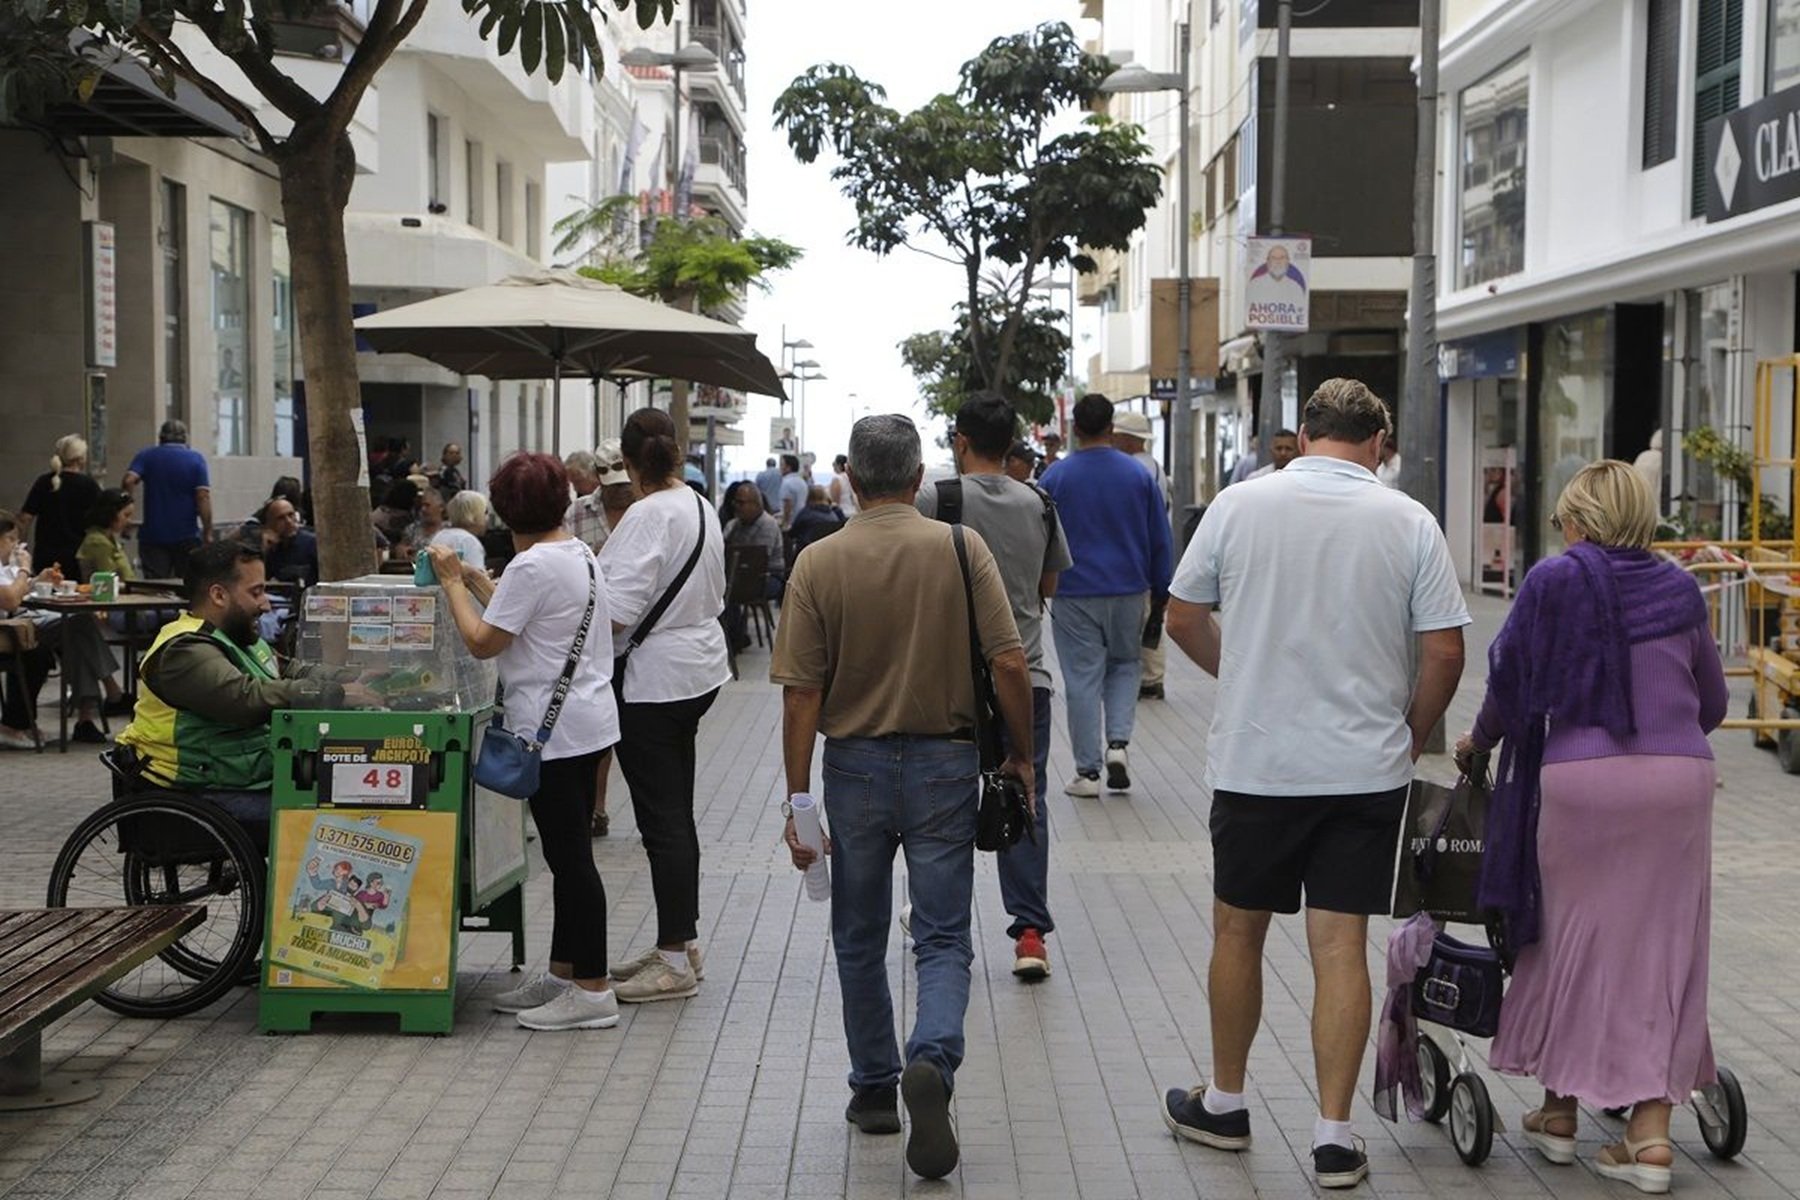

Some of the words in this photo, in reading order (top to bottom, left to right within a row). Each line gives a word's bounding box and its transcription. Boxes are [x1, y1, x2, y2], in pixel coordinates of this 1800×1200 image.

[1755, 111, 1800, 182] CLA
[1248, 313, 1305, 325] POSIBLE
[1249, 302, 1297, 314] AHORA
[582, 604, 594, 629] YOU
[569, 629, 587, 662] LOVE
[554, 675, 570, 701] SEE
[543, 703, 561, 729] YOU
[323, 753, 351, 763] BOTE
[352, 754, 368, 763] DE
[319, 827, 402, 858] 1.371.575.000
[402, 846, 412, 860] €
[290, 935, 317, 954] TOCA
[316, 943, 327, 956] A
